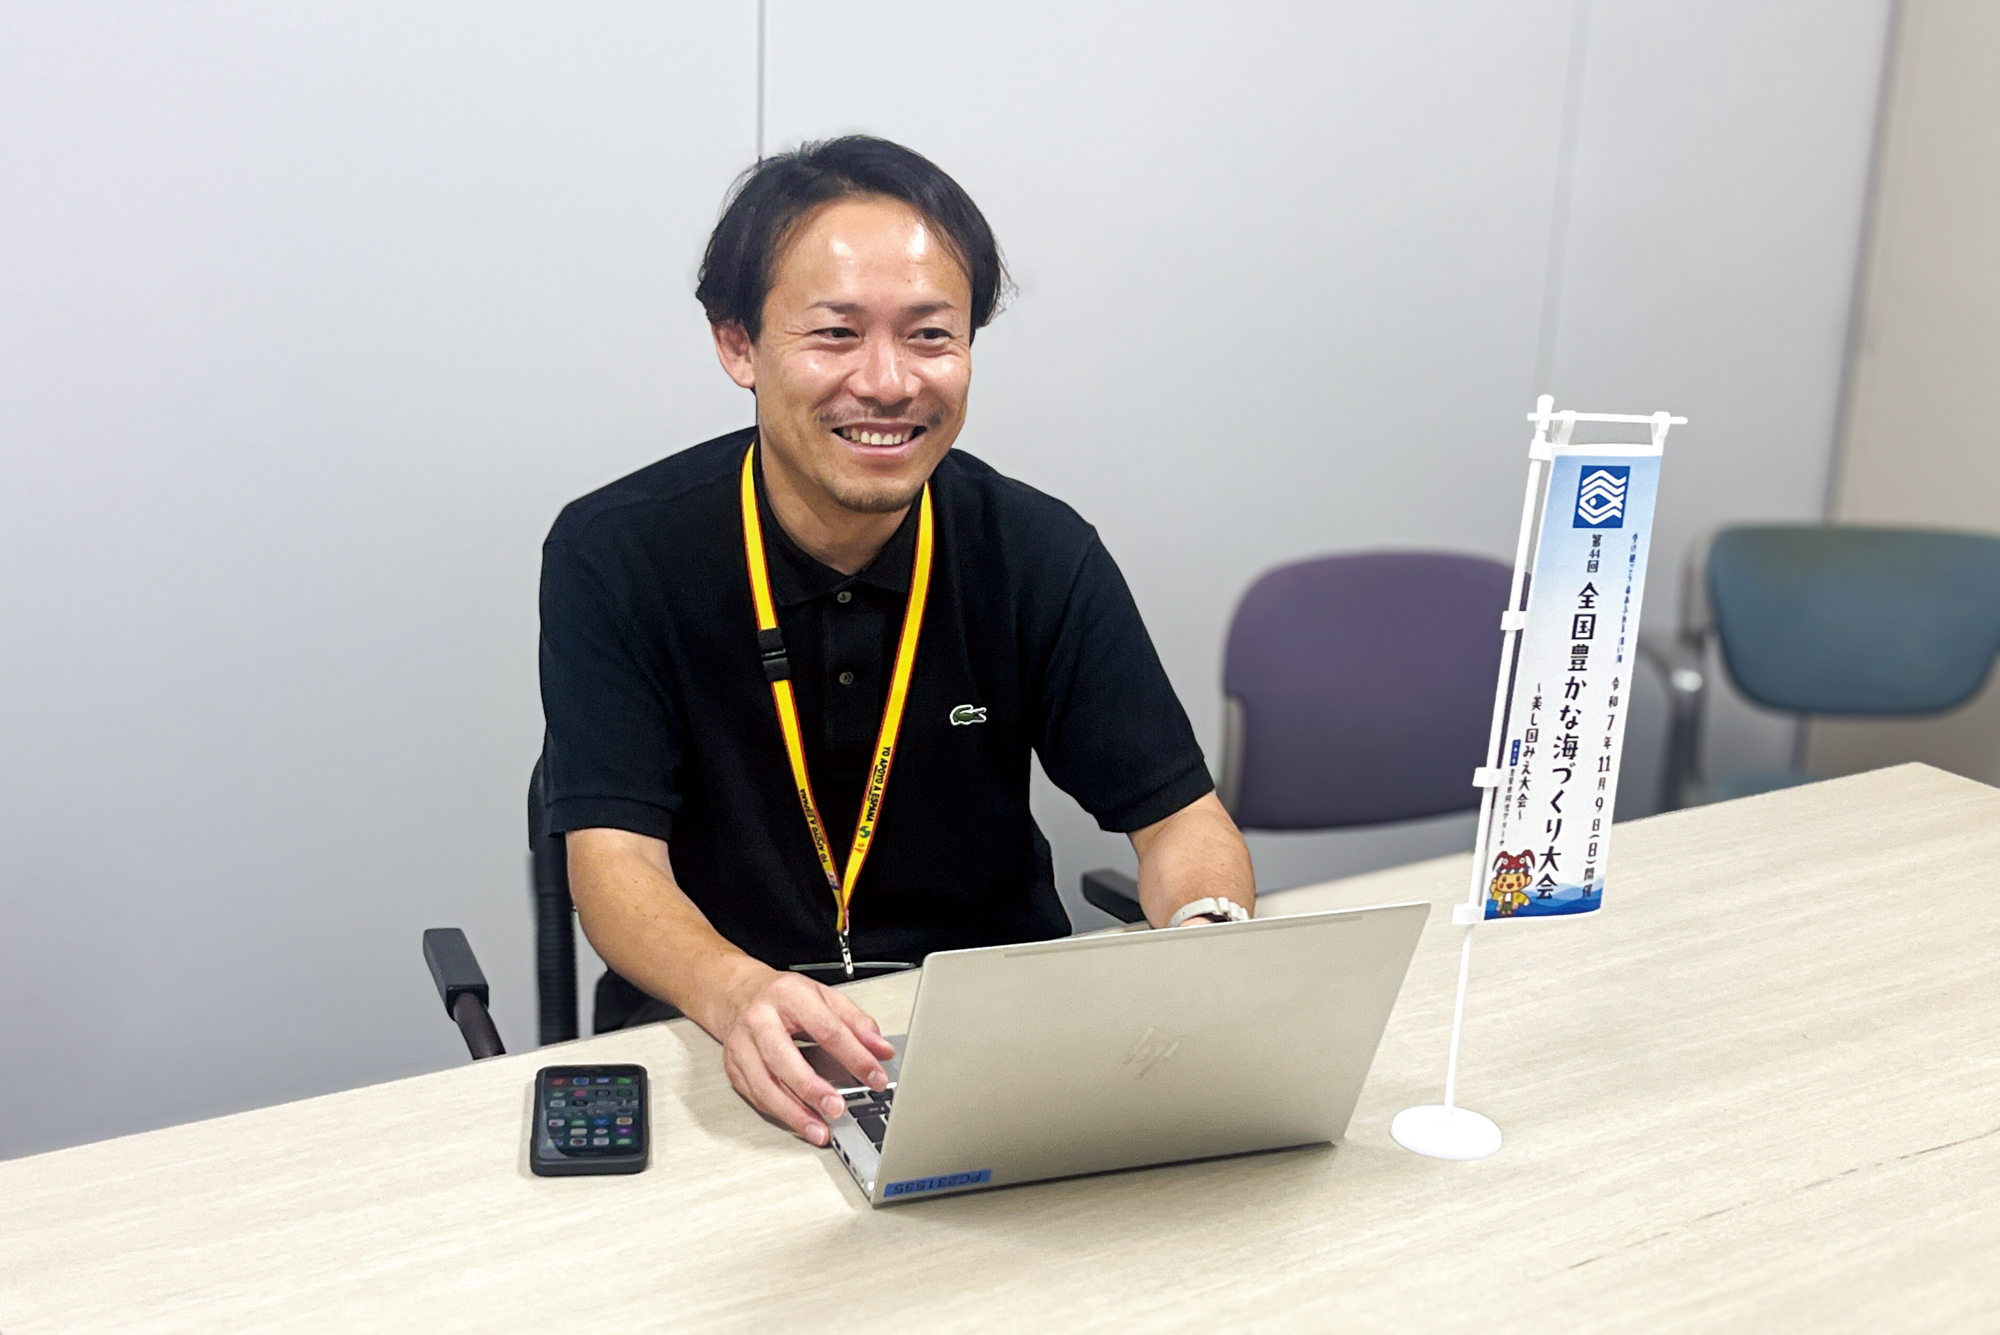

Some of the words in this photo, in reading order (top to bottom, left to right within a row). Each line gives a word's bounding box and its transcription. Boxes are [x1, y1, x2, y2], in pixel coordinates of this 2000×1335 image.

[1586, 534, 1602, 573] 第44回
[1535, 581, 1600, 900] 全国豊かな海づくり大会
[875, 758, 888, 784] APOYO
